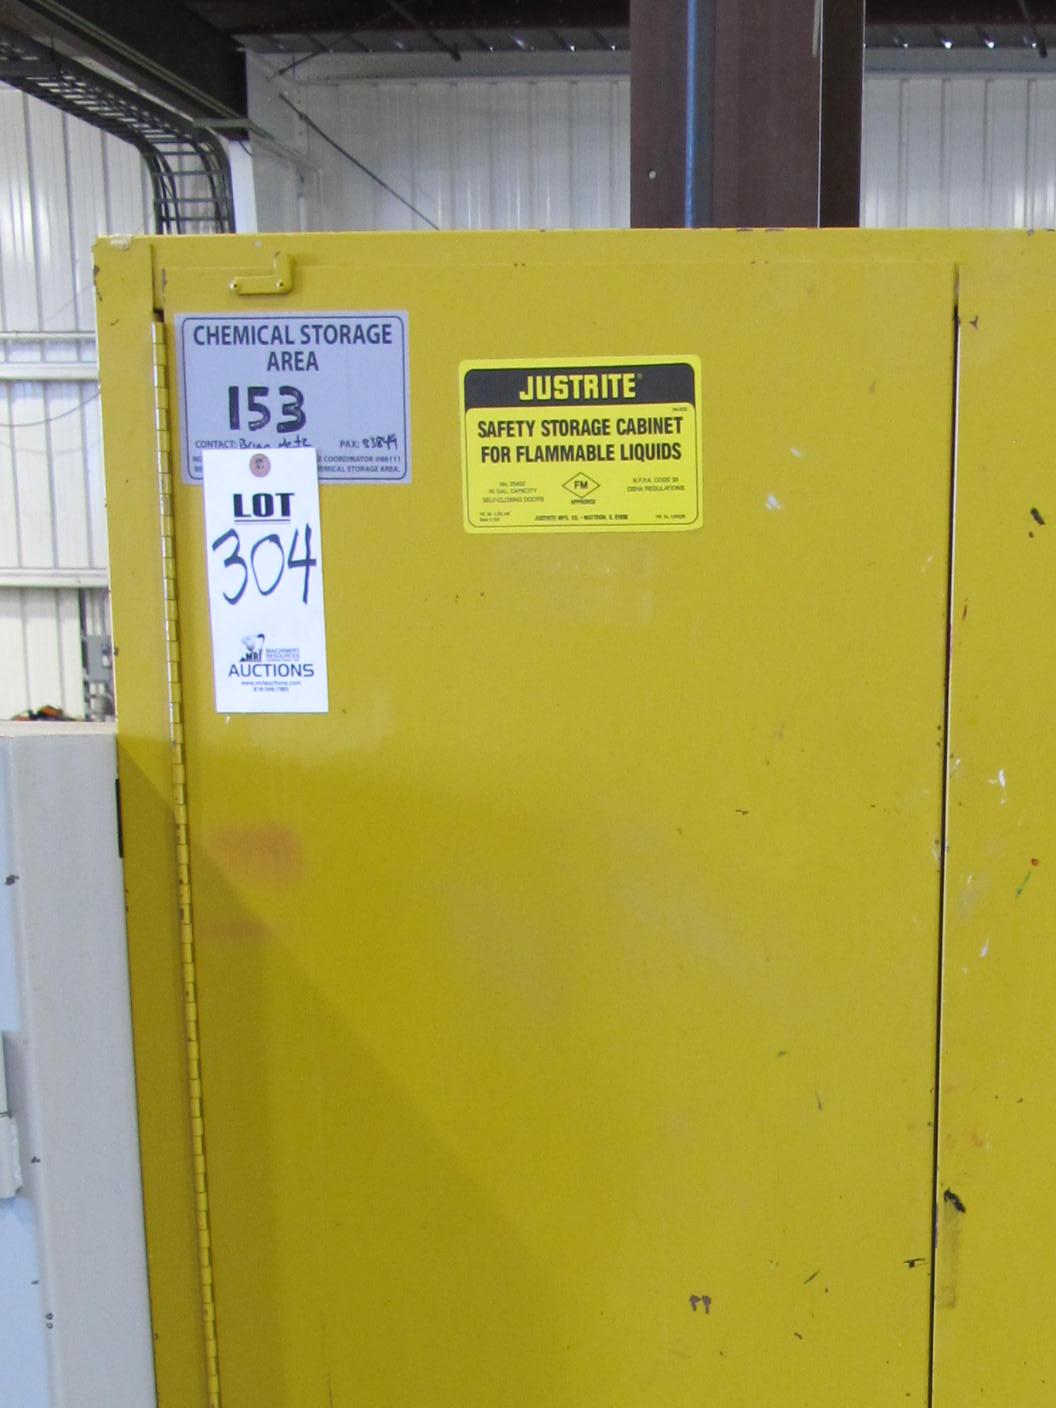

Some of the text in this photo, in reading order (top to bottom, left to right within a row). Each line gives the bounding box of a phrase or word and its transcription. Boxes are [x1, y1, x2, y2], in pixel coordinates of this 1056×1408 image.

[193, 323, 392, 346] CHEMICAL STORAGE
[266, 351, 319, 372] AREA
[519, 373, 636, 401] JUSTRITE
[228, 385, 306, 433] 153
[478, 416, 683, 438] SAFETY STORAGE CABINET
[195, 440, 236, 449] CONTACT:
[481, 442, 682, 463] FOR FLAMMABLE LIQUIDS
[574, 480, 588, 490] FM
[233, 492, 295, 518] LOT
[212, 523, 317, 606] 304
[228, 664, 315, 678] AUCTIONS
